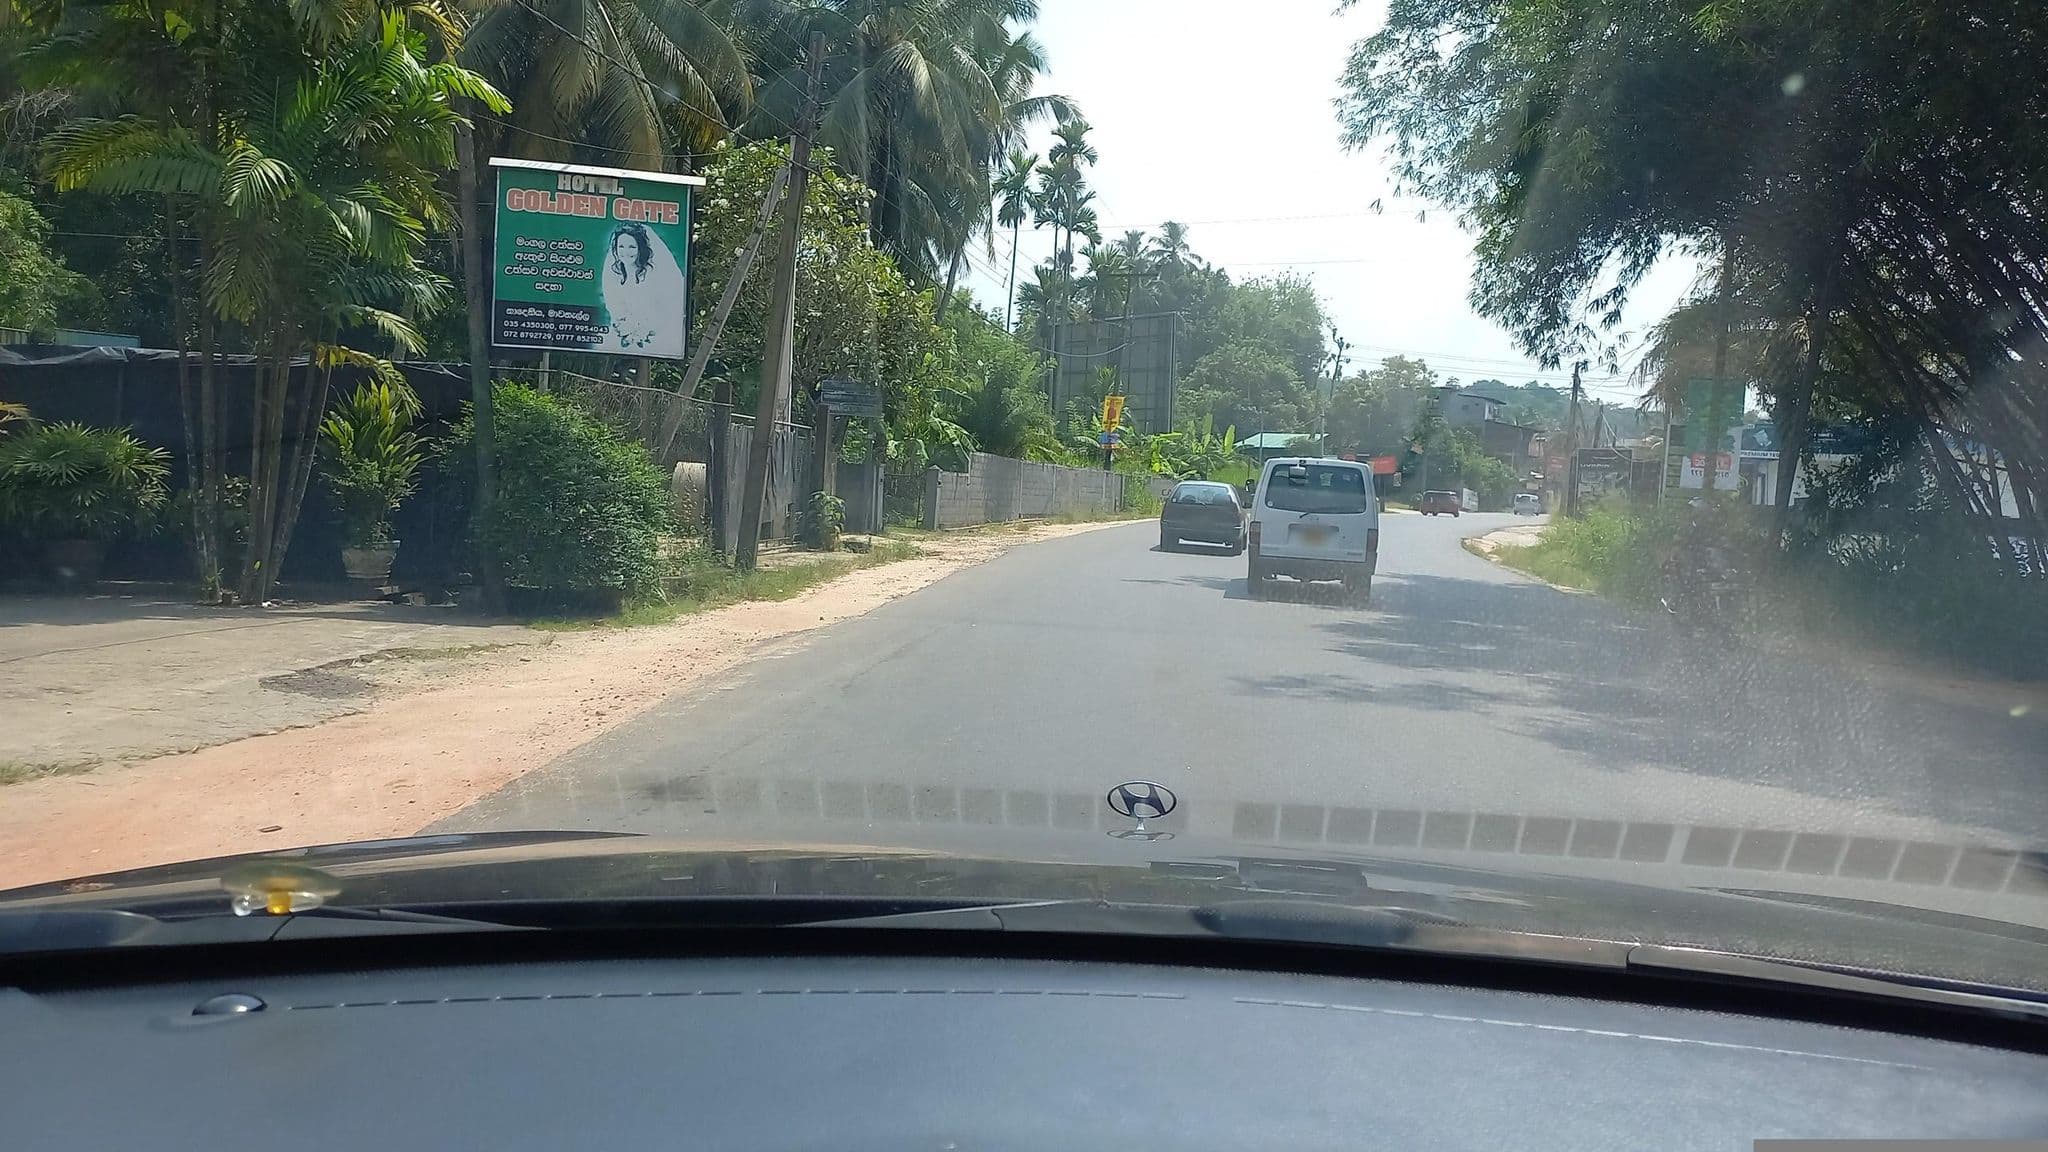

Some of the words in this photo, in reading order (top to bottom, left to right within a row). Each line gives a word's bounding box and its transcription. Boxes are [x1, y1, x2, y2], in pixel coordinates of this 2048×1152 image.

[557, 173, 624, 196] HOTEL
[506, 188, 607, 219] GOLDEN
[612, 198, 679, 225] GATE
[549, 238, 584, 250] උත්සව
[504, 264, 538, 275] උත්සව
[503, 320, 518, 328] 035
[558, 324, 573, 332] 077
[503, 330, 518, 338] 072
[555, 333, 574, 341] 0777
